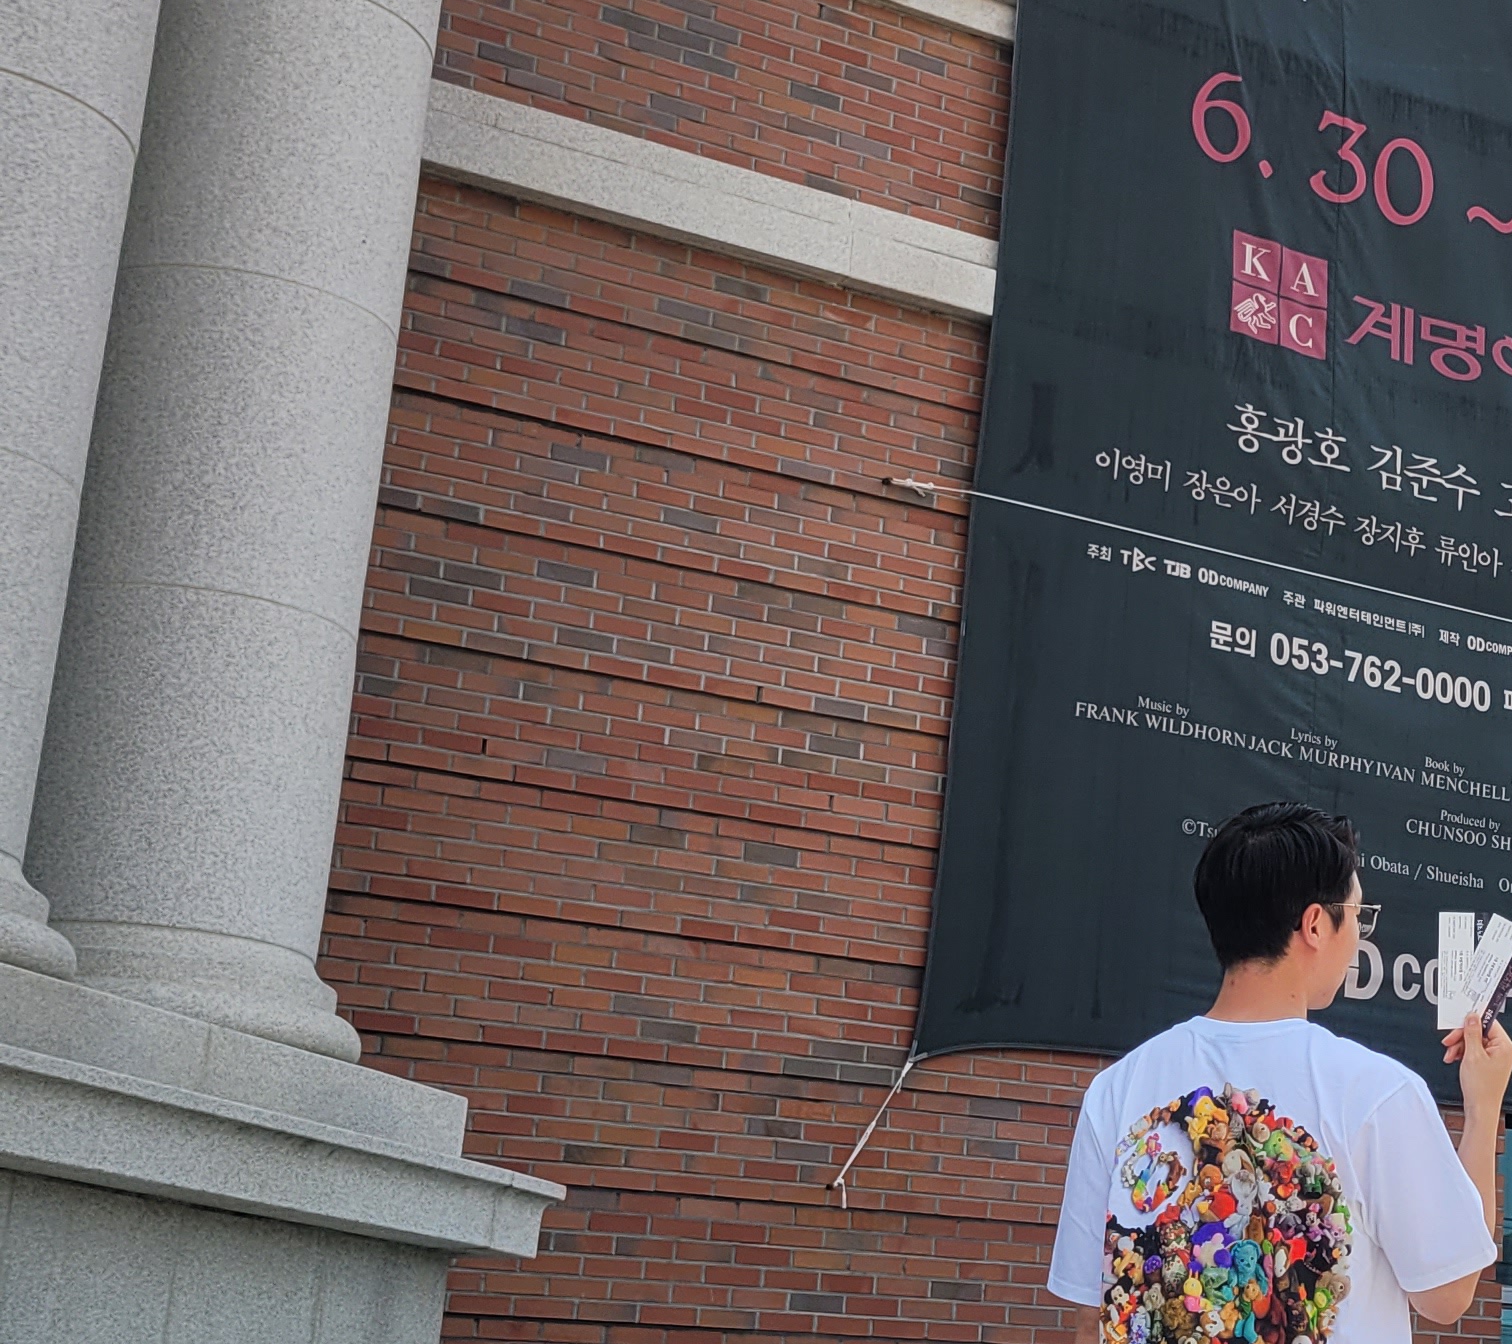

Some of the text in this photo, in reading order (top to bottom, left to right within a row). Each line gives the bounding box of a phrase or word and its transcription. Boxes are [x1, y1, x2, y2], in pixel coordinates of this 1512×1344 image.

[1191, 71, 1274, 179] 6.
[1309, 109, 1435, 227] 30
[1226, 402, 1351, 472] 홍광호
[1366, 444, 1482, 512] 김준수
[1095, 447, 1172, 492] 이영미
[1183, 469, 1262, 516] 장은아
[1270, 493, 1347, 536] 서경수
[1354, 515, 1427, 558] 장지후
[1434, 534, 1503, 578] 류인아
[1085, 542, 1112, 563] 주최
[1118, 546, 1158, 573] TBC
[1163, 558, 1192, 580] TJB
[1282, 590, 1307, 609] 주관
[1438, 627, 1461, 647] 제작
[1209, 620, 1258, 658] 문의
[1269, 632, 1491, 714] 053-762-0000
[1074, 701, 1247, 749] FRANK WILDHORN
[1137, 695, 1190, 719] Music by
[1247, 736, 1374, 775] JACK MURPHY
[1290, 727, 1338, 750] Lyrics by
[1375, 761, 1511, 803] IVAN MENCHELL
[1424, 755, 1466, 777] Book by
[1405, 817, 1488, 849] CHUNSOO
[1439, 808, 1501, 833] Produced by
[1370, 854, 1410, 876] Obata
[1426, 864, 1485, 890] Shueisha
